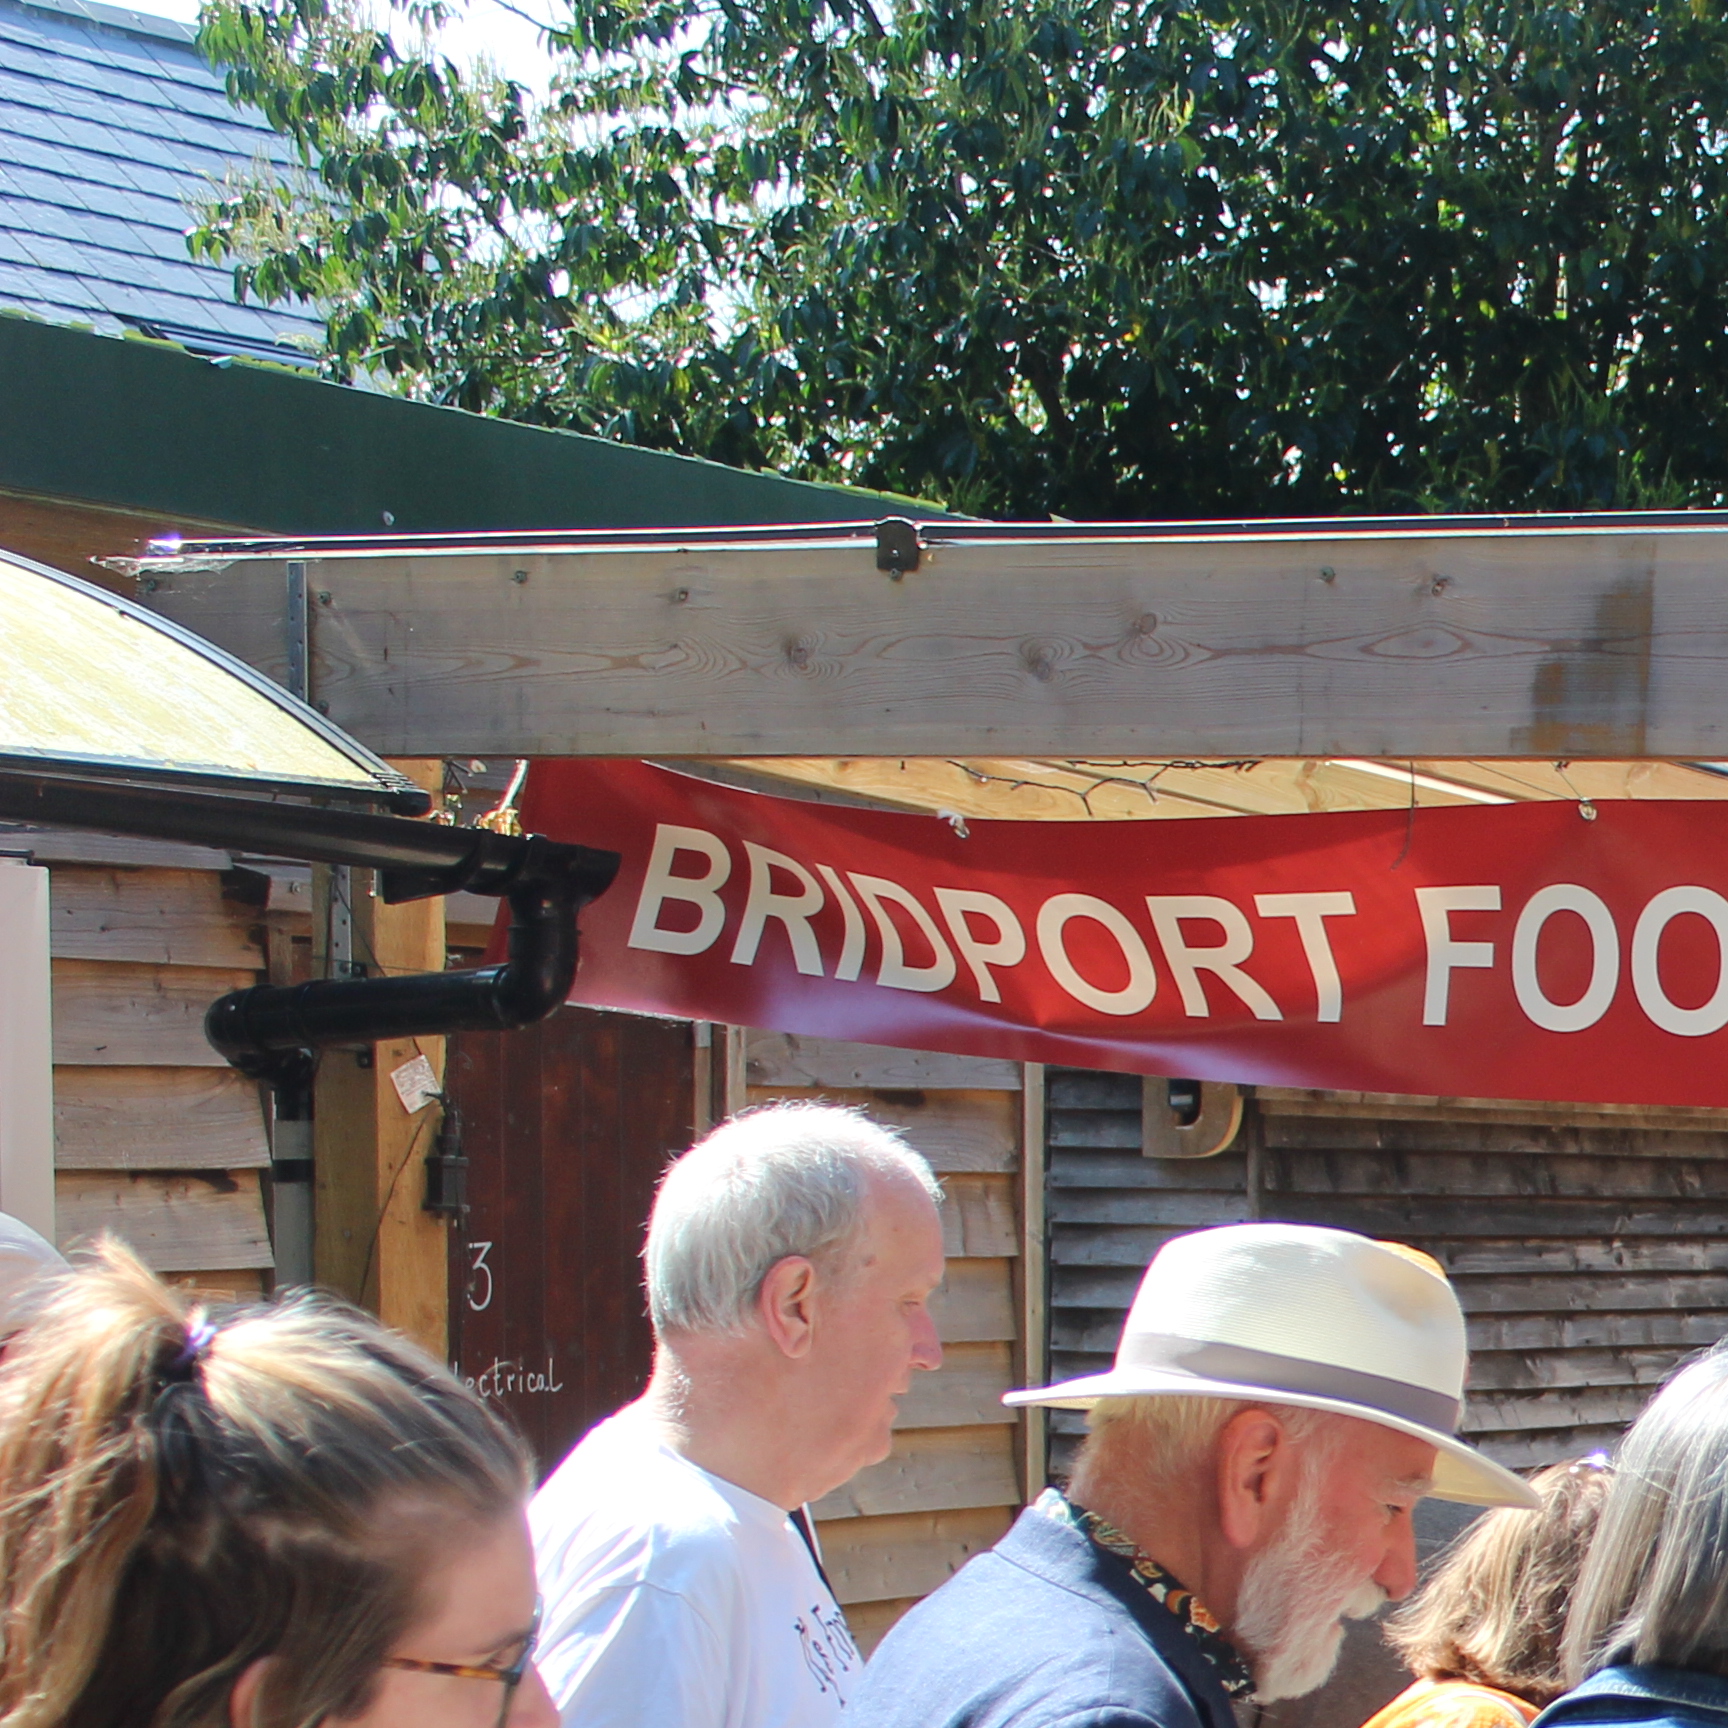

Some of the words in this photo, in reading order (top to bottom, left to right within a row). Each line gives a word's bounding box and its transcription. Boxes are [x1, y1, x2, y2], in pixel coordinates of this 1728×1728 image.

[628, 822, 1356, 1024] BRIDPORT
[467, 1241, 493, 1312] 3
[453, 1356, 564, 1398] lectrical
